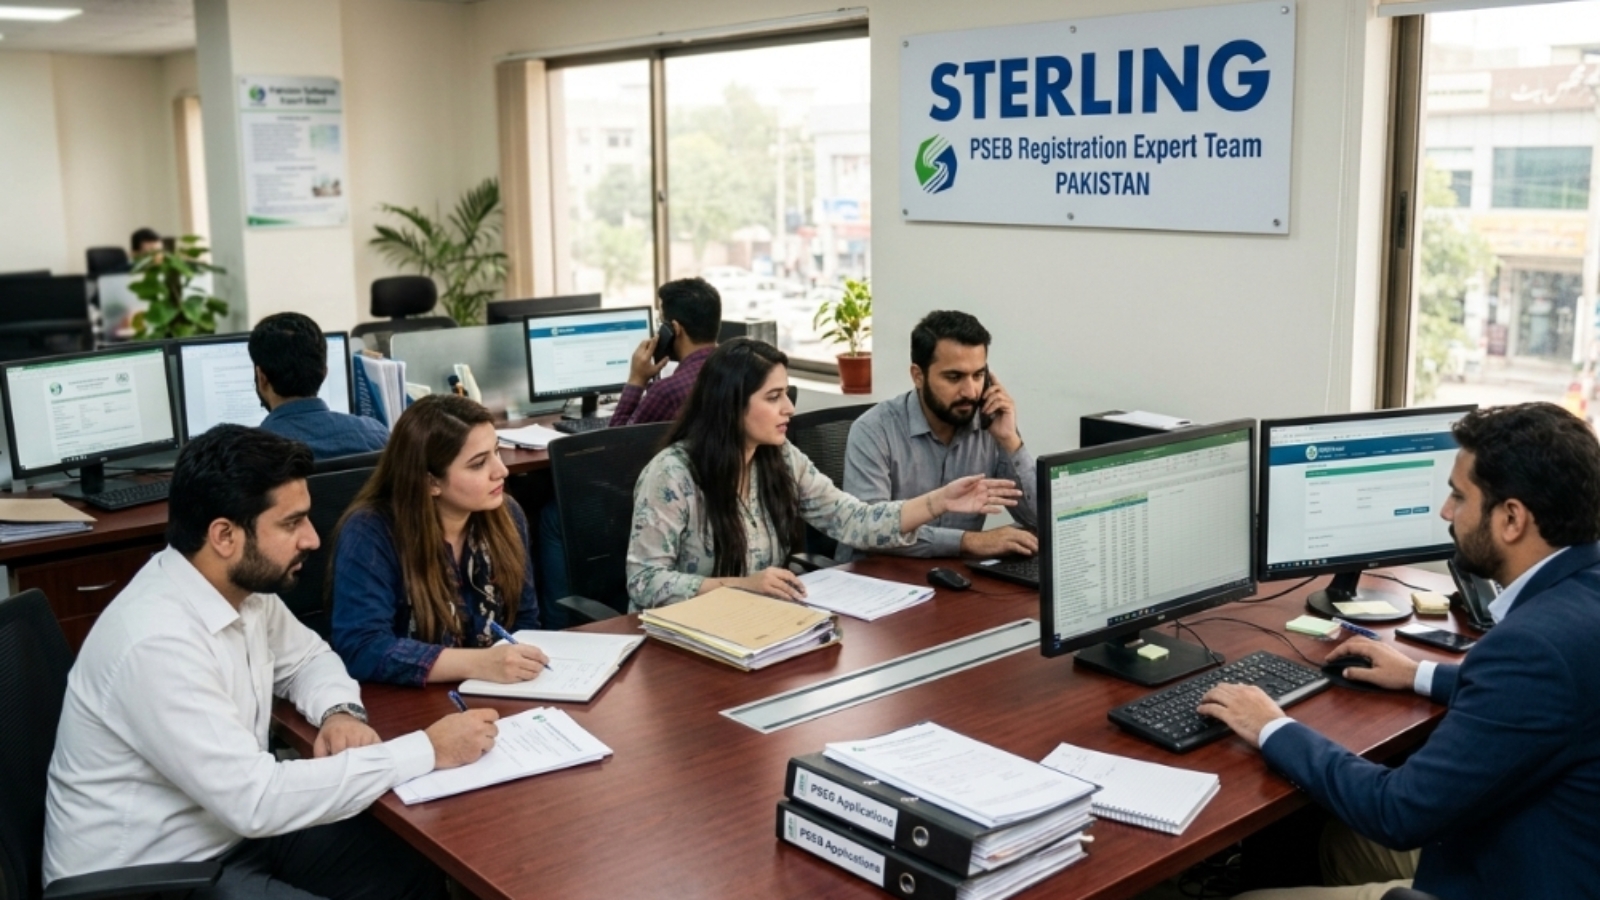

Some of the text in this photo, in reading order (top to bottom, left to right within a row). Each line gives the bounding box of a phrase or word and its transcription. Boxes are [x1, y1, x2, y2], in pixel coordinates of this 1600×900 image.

[929, 39, 1270, 122] STERLING
[970, 132, 1262, 164] PSEB Registration Expert Team
[1055, 171, 1150, 196] PAKISTAN
[836, 795, 894, 828] Applications
